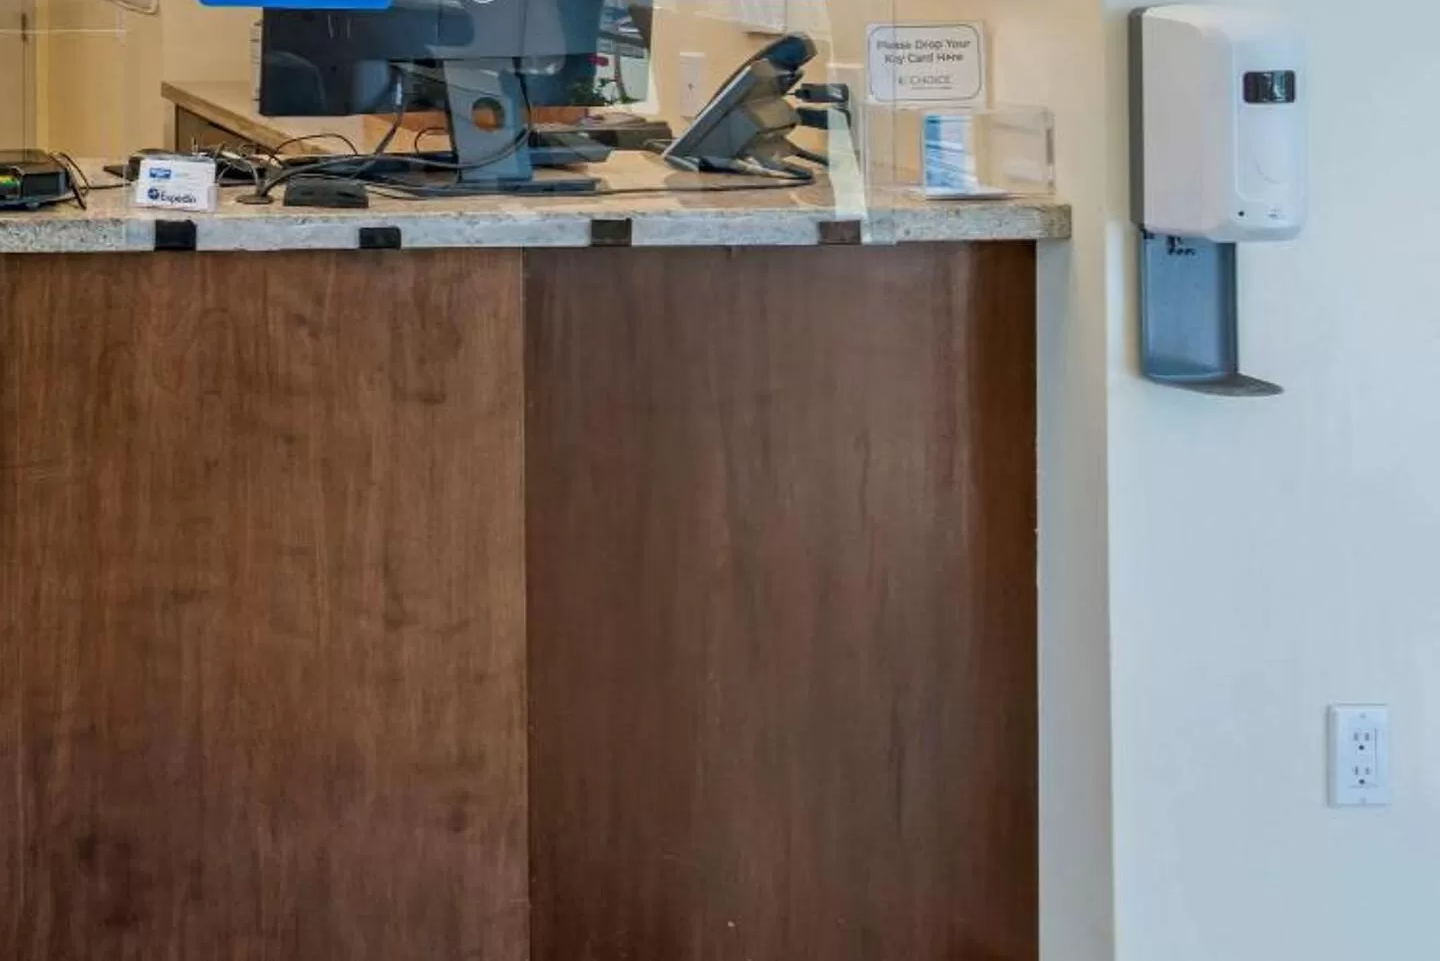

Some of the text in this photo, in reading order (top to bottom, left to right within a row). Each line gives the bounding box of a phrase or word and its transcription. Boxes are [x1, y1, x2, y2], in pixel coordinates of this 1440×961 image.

[876, 39, 972, 51] Please Drop Your
[884, 52, 964, 65] Key Card Here
